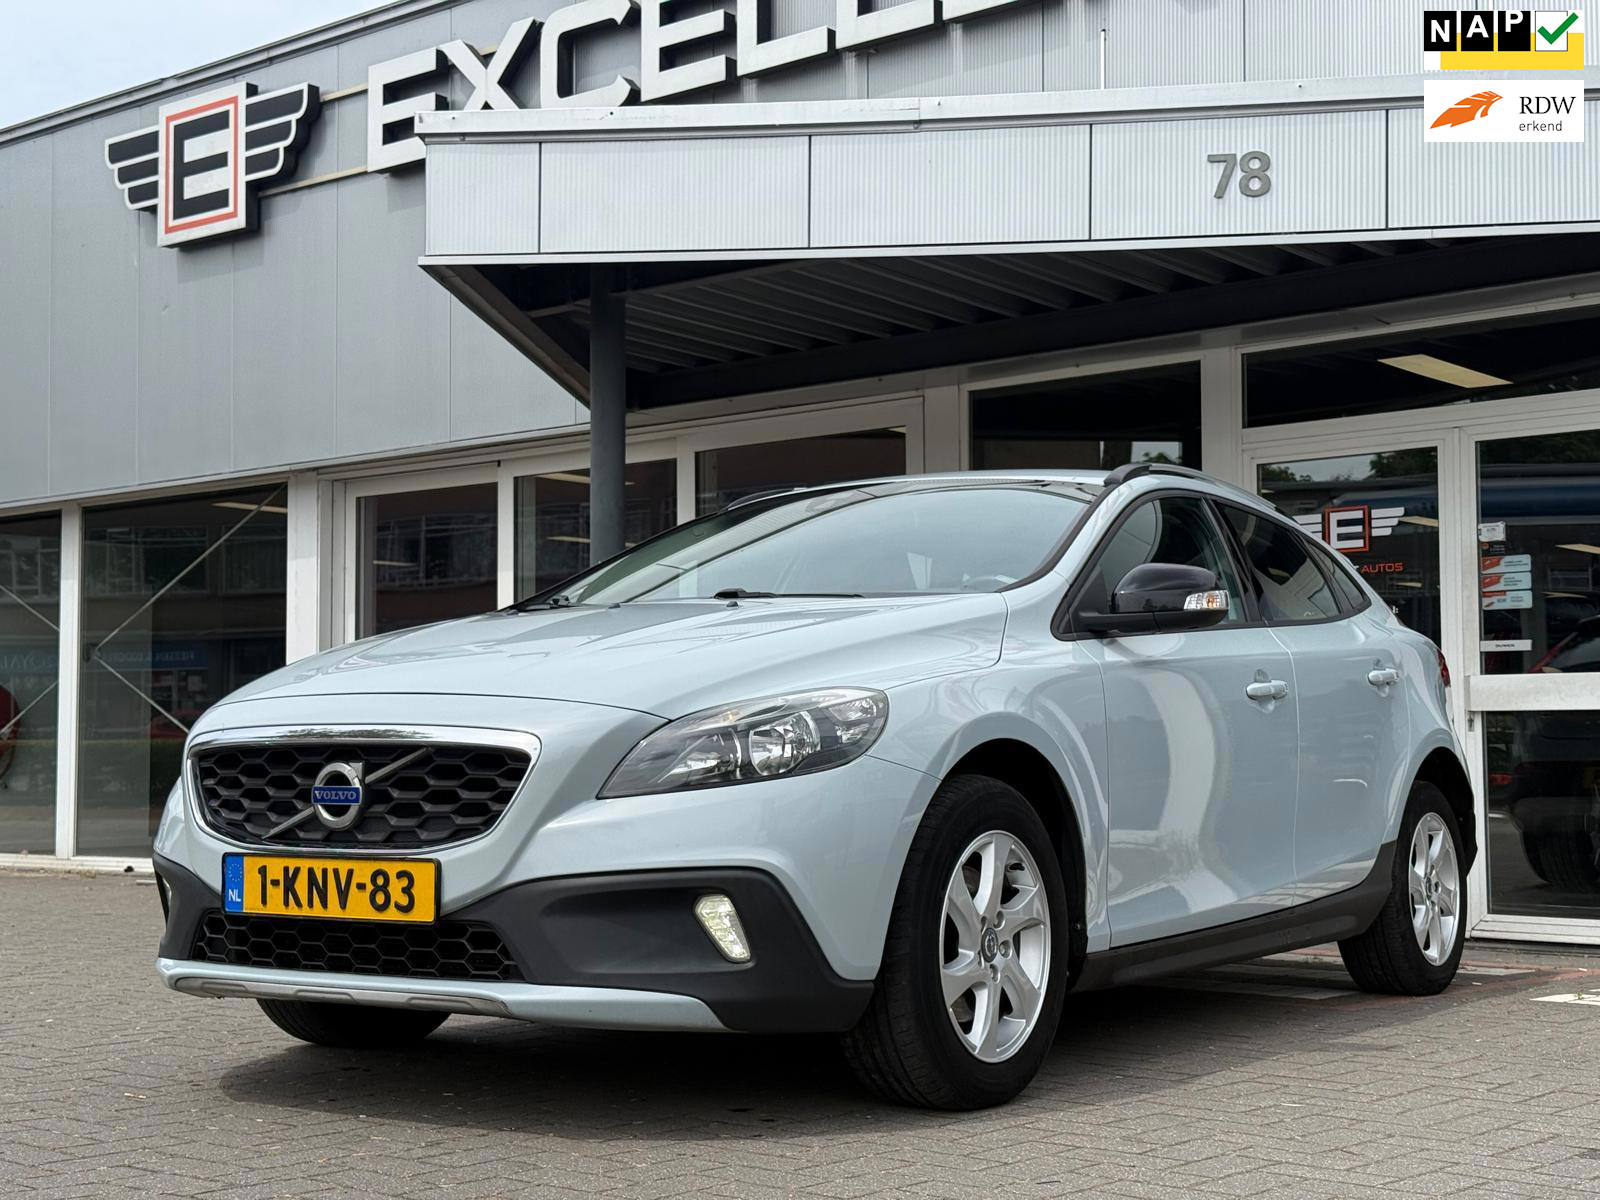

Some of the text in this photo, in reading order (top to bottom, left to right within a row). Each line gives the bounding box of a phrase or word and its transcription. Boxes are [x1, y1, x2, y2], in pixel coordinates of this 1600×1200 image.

[1207, 150, 1272, 199] 78
[1360, 562, 1404, 574] AUTOS
[314, 789, 357, 801] VOLVO
[228, 888, 242, 903] NL
[258, 864, 416, 914] 1-KNV-83
